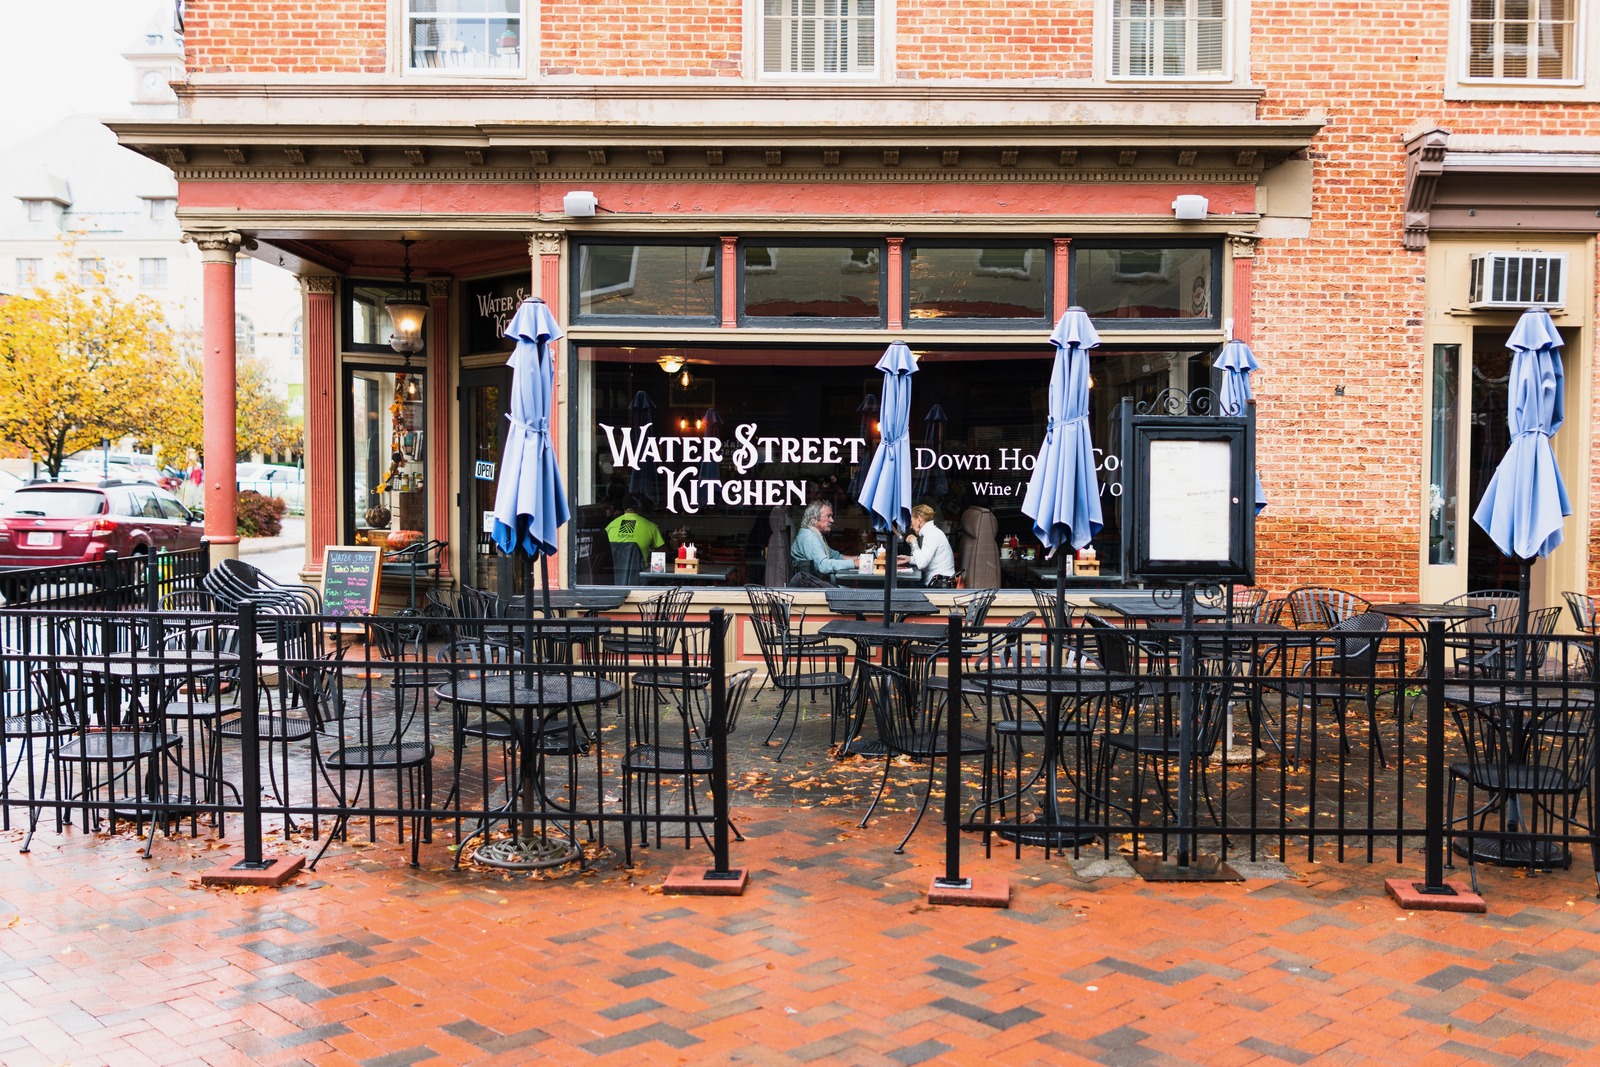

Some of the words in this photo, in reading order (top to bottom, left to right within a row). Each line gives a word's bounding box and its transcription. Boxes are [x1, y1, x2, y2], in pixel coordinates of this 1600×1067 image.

[476, 291, 514, 318] WATER
[598, 422, 723, 471] WATER
[732, 422, 867, 475] STREET
[914, 447, 991, 471] Down
[476, 462, 494, 479] OPEN
[656, 465, 807, 514] KITCHEN
[972, 482, 1012, 496] Wine
[331, 553, 351, 562] WATER
[353, 554, 373, 563] STREET
